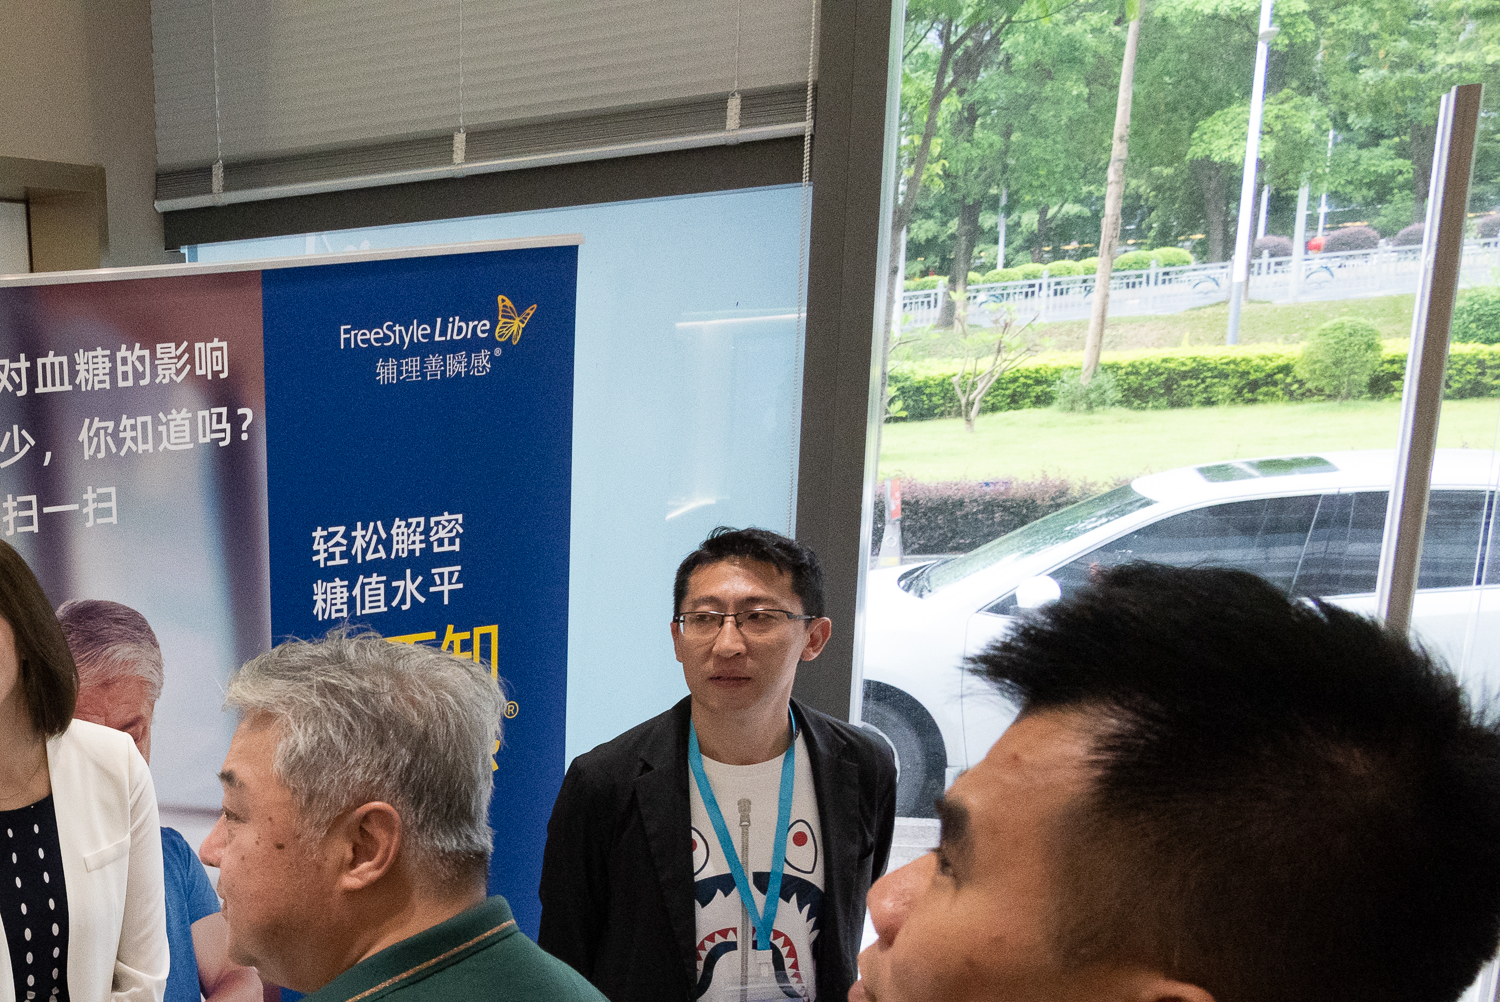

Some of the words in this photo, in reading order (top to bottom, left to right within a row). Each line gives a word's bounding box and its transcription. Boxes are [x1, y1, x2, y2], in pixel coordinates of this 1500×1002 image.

[340, 319, 431, 350] FreeStyle
[434, 316, 490, 342] Libre
[311, 511, 464, 568] 轻松解密
[312, 565, 464, 622] 糖值水平
